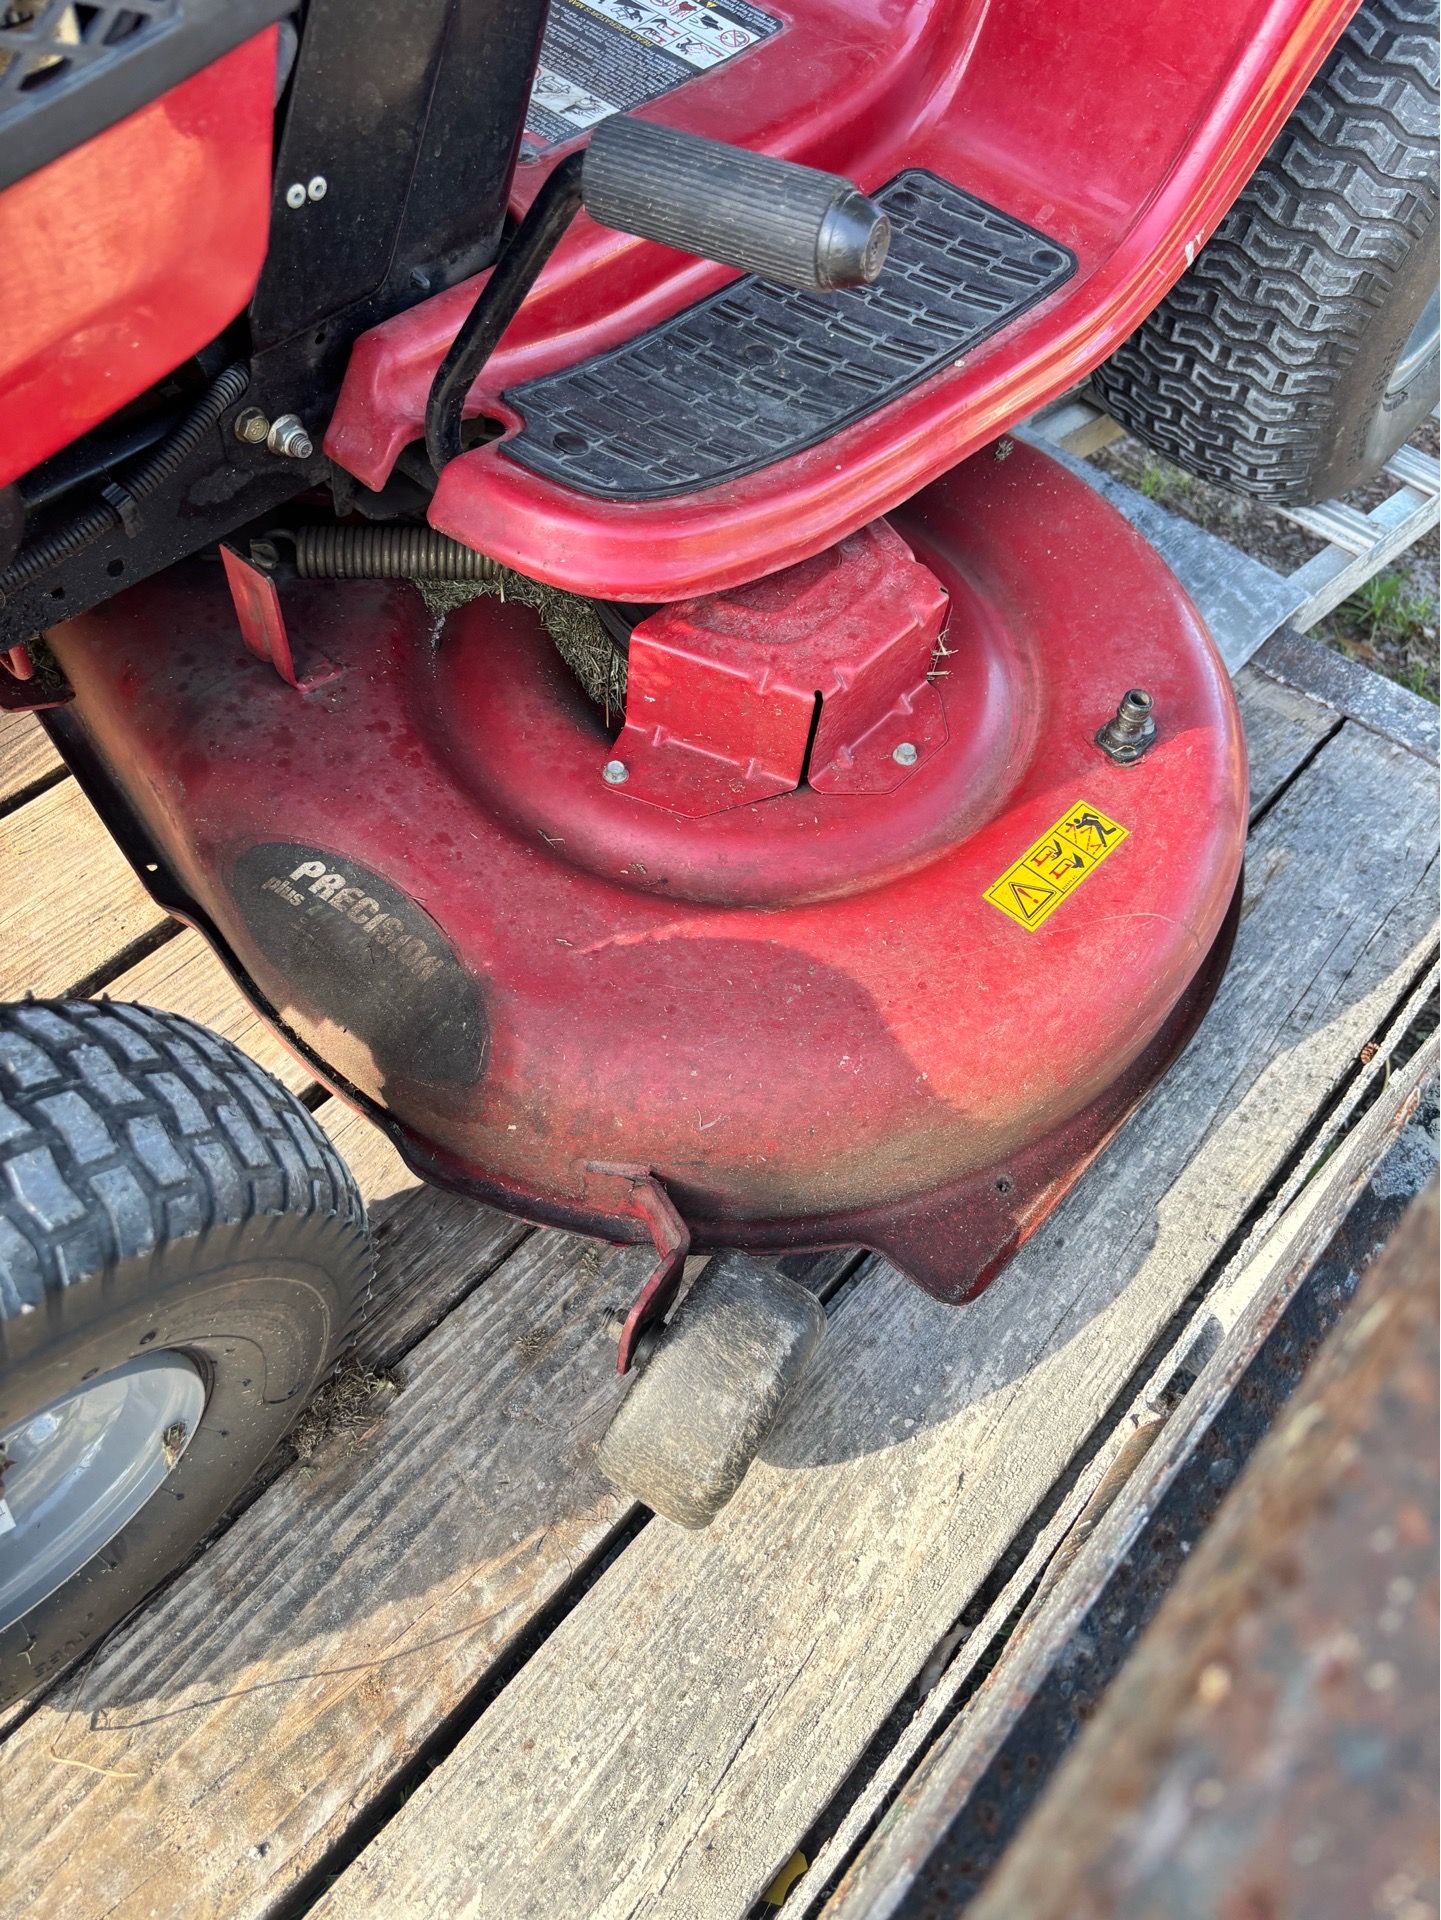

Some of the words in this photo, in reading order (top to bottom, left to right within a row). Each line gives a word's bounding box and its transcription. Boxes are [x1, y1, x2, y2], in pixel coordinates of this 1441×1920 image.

[582, 6, 632, 34] OPERATOR'S
[629, 33, 654, 47] READ
[545, 135, 559, 143] TO
[261, 877, 305, 906] plus
